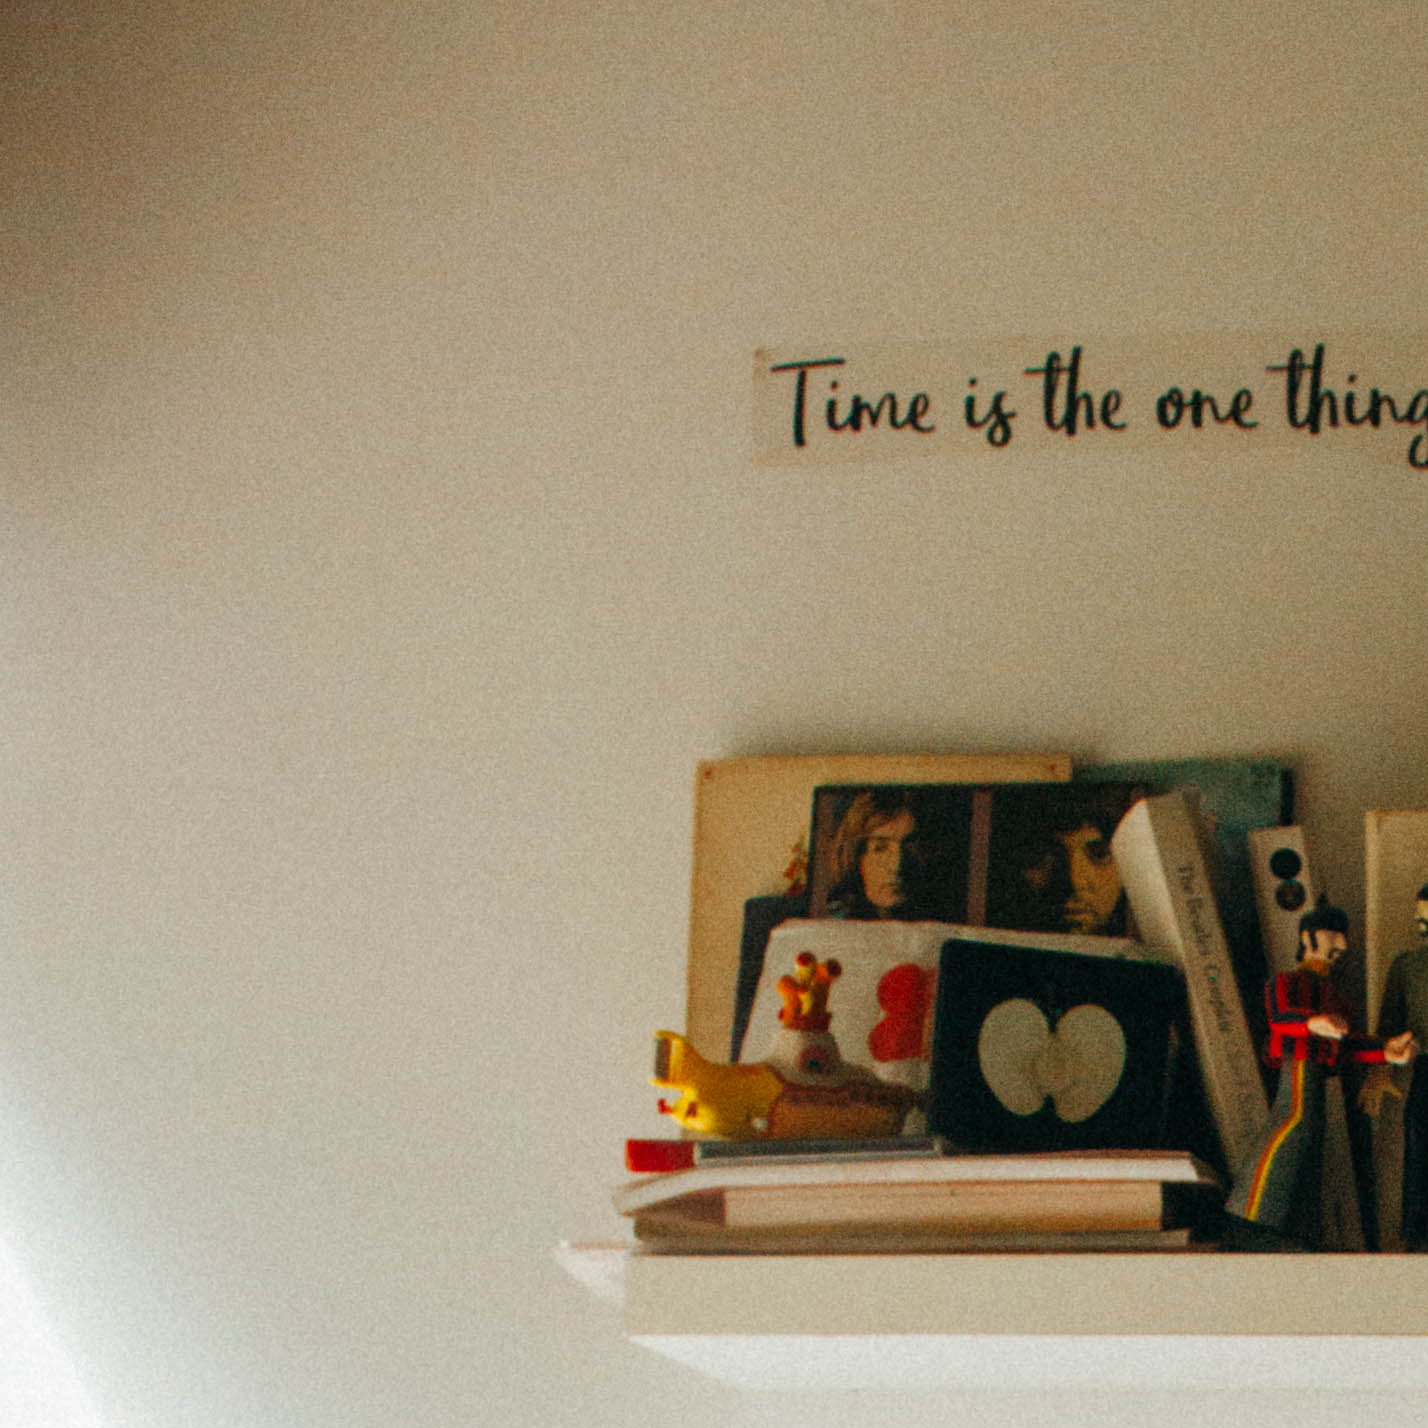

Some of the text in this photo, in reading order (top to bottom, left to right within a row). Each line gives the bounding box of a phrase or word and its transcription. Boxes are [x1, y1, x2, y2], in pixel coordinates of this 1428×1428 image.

[771, 359, 932, 448] Time
[964, 379, 1016, 447] is
[1025, 346, 1126, 438] the
[1155, 386, 1258, 431] one
